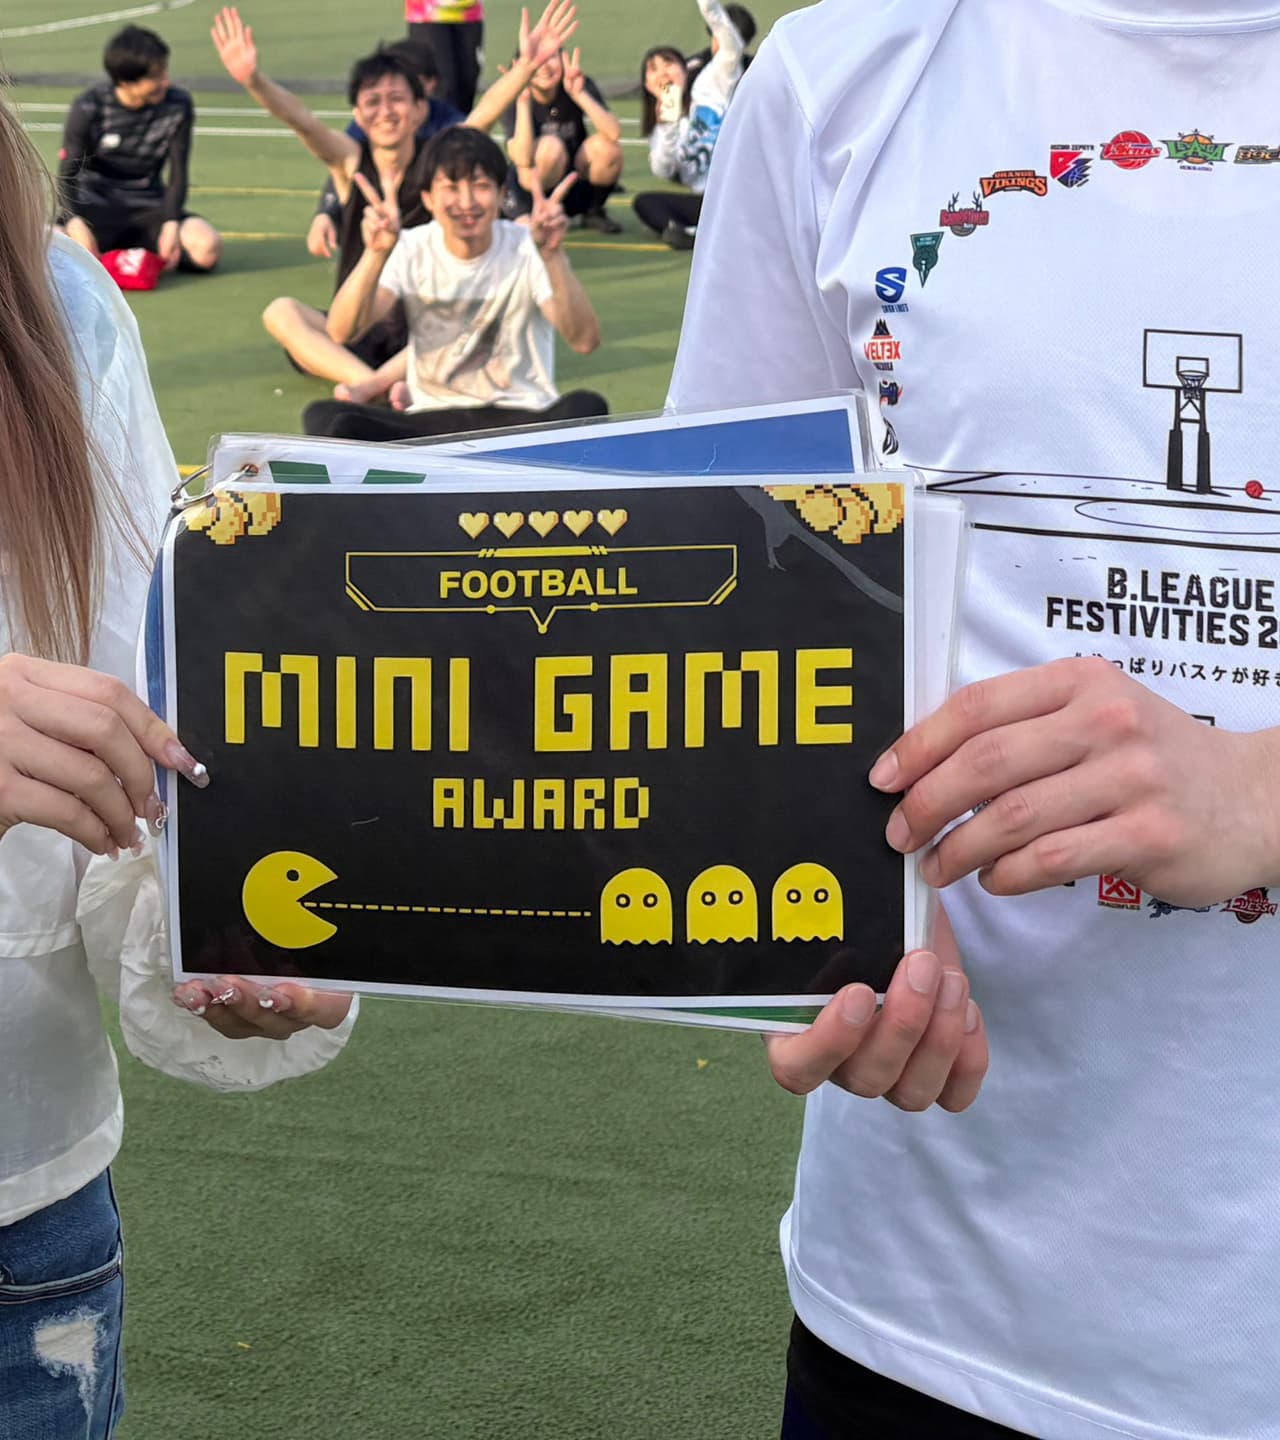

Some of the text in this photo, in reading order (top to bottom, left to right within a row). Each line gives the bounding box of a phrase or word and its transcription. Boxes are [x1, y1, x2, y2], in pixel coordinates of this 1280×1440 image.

[981, 178, 1047, 197] VIKINGS
[438, 566, 639, 600] FOOTBALL
[1107, 566, 1276, 612] B.LEAGUE
[1045, 596, 1250, 646] FESTIVITIES
[223, 647, 854, 753] MINI GAME
[431, 776, 650, 831] AWARD
